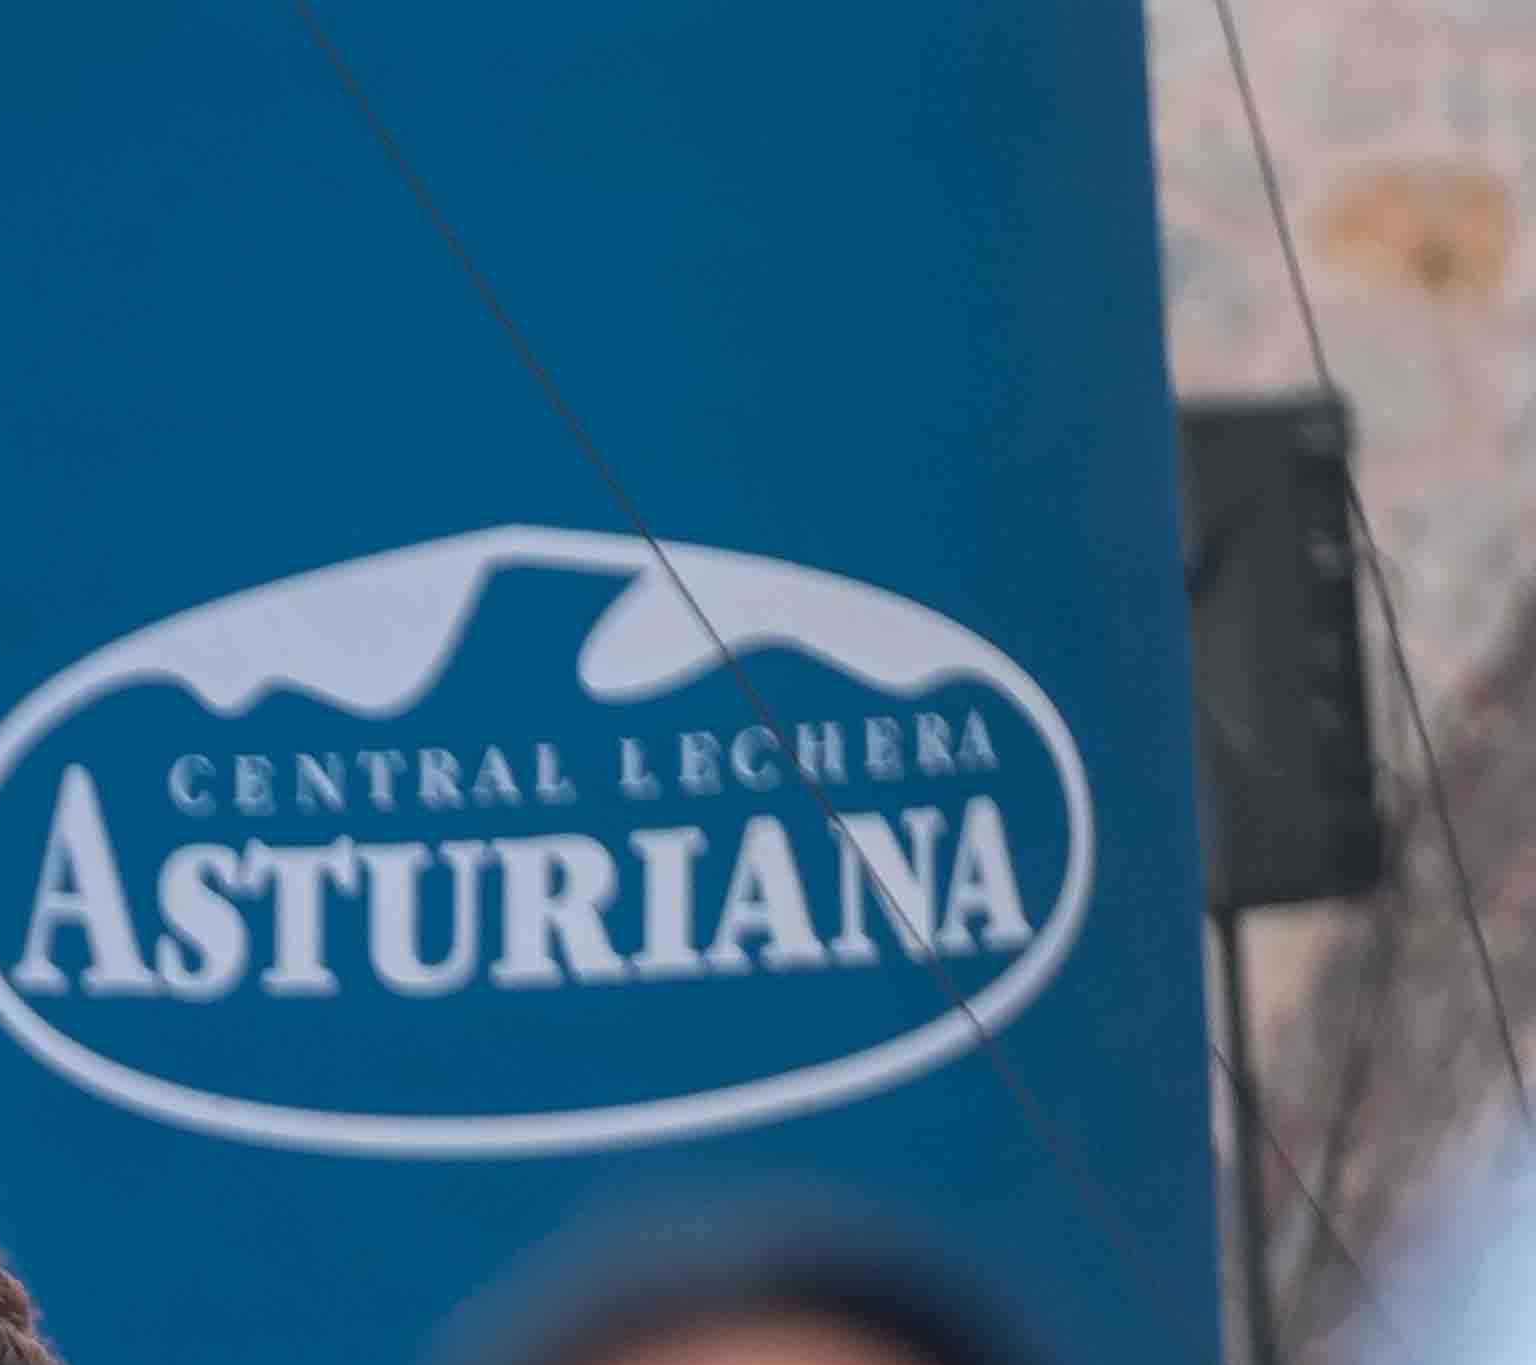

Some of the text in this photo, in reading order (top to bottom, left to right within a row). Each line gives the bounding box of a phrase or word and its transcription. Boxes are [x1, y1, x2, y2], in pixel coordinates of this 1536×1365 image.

[167, 709, 1001, 816] CENTRAL LECHERA
[14, 764, 1035, 1001] ASTURIANA
